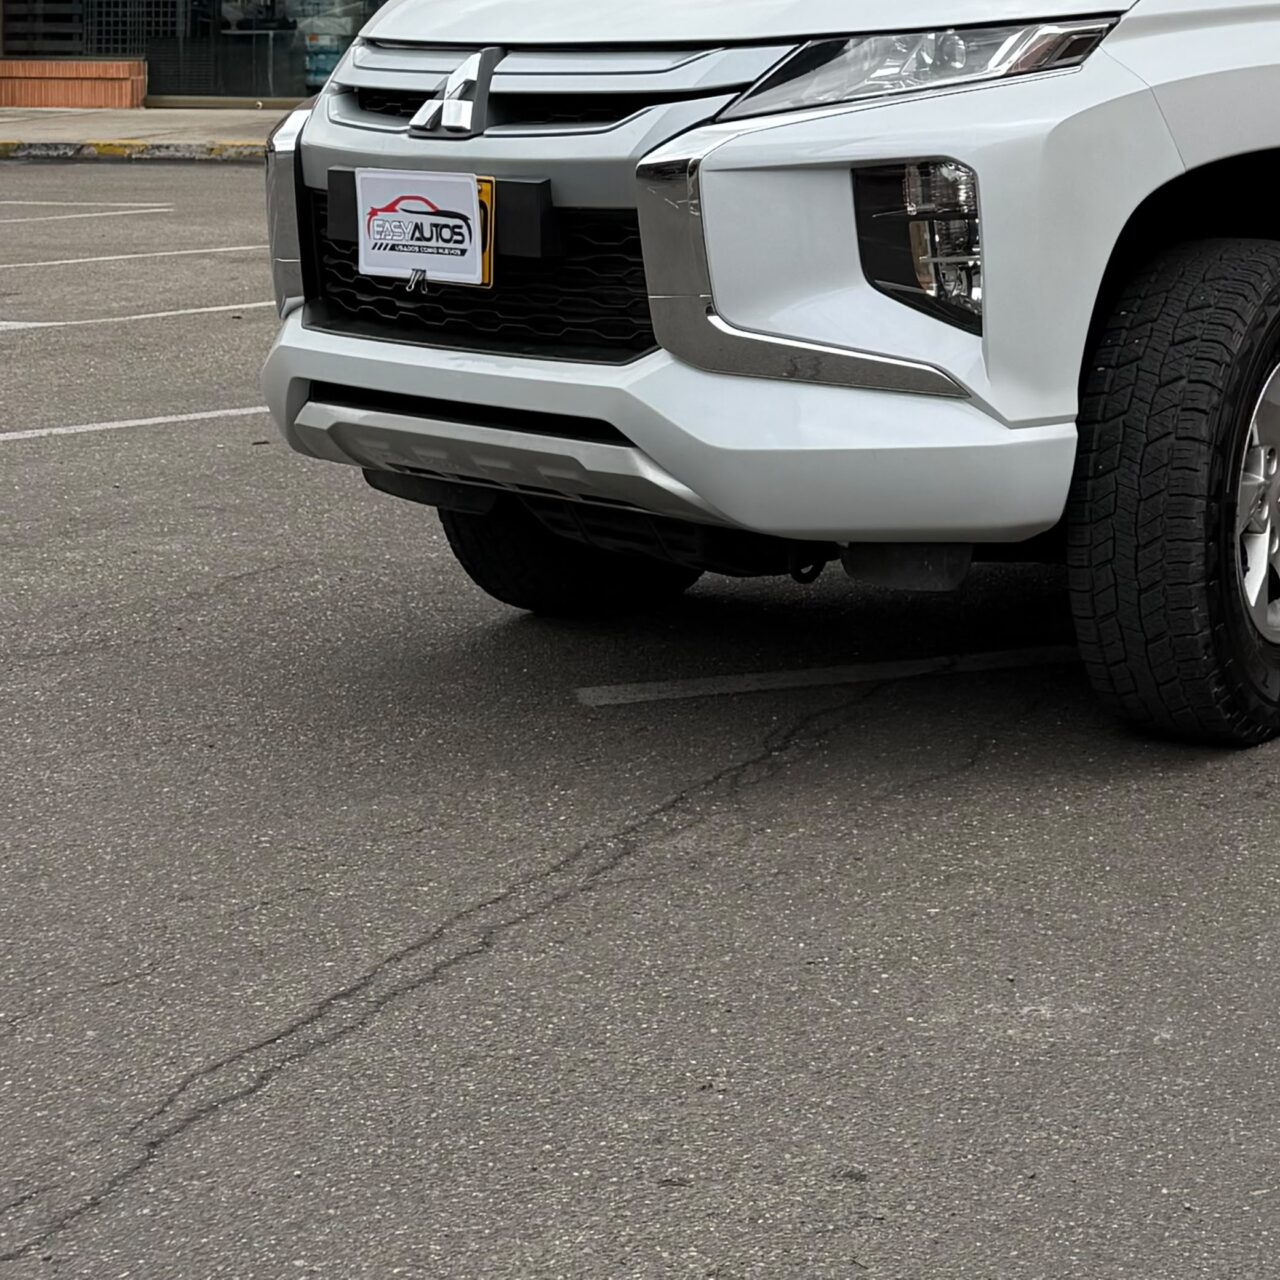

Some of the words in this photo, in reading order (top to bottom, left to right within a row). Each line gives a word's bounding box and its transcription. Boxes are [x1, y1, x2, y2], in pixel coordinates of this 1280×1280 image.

[394, 244, 419, 253] USADOS
[420, 246, 438, 255] COMO
[438, 247, 462, 257] NUEVOS
